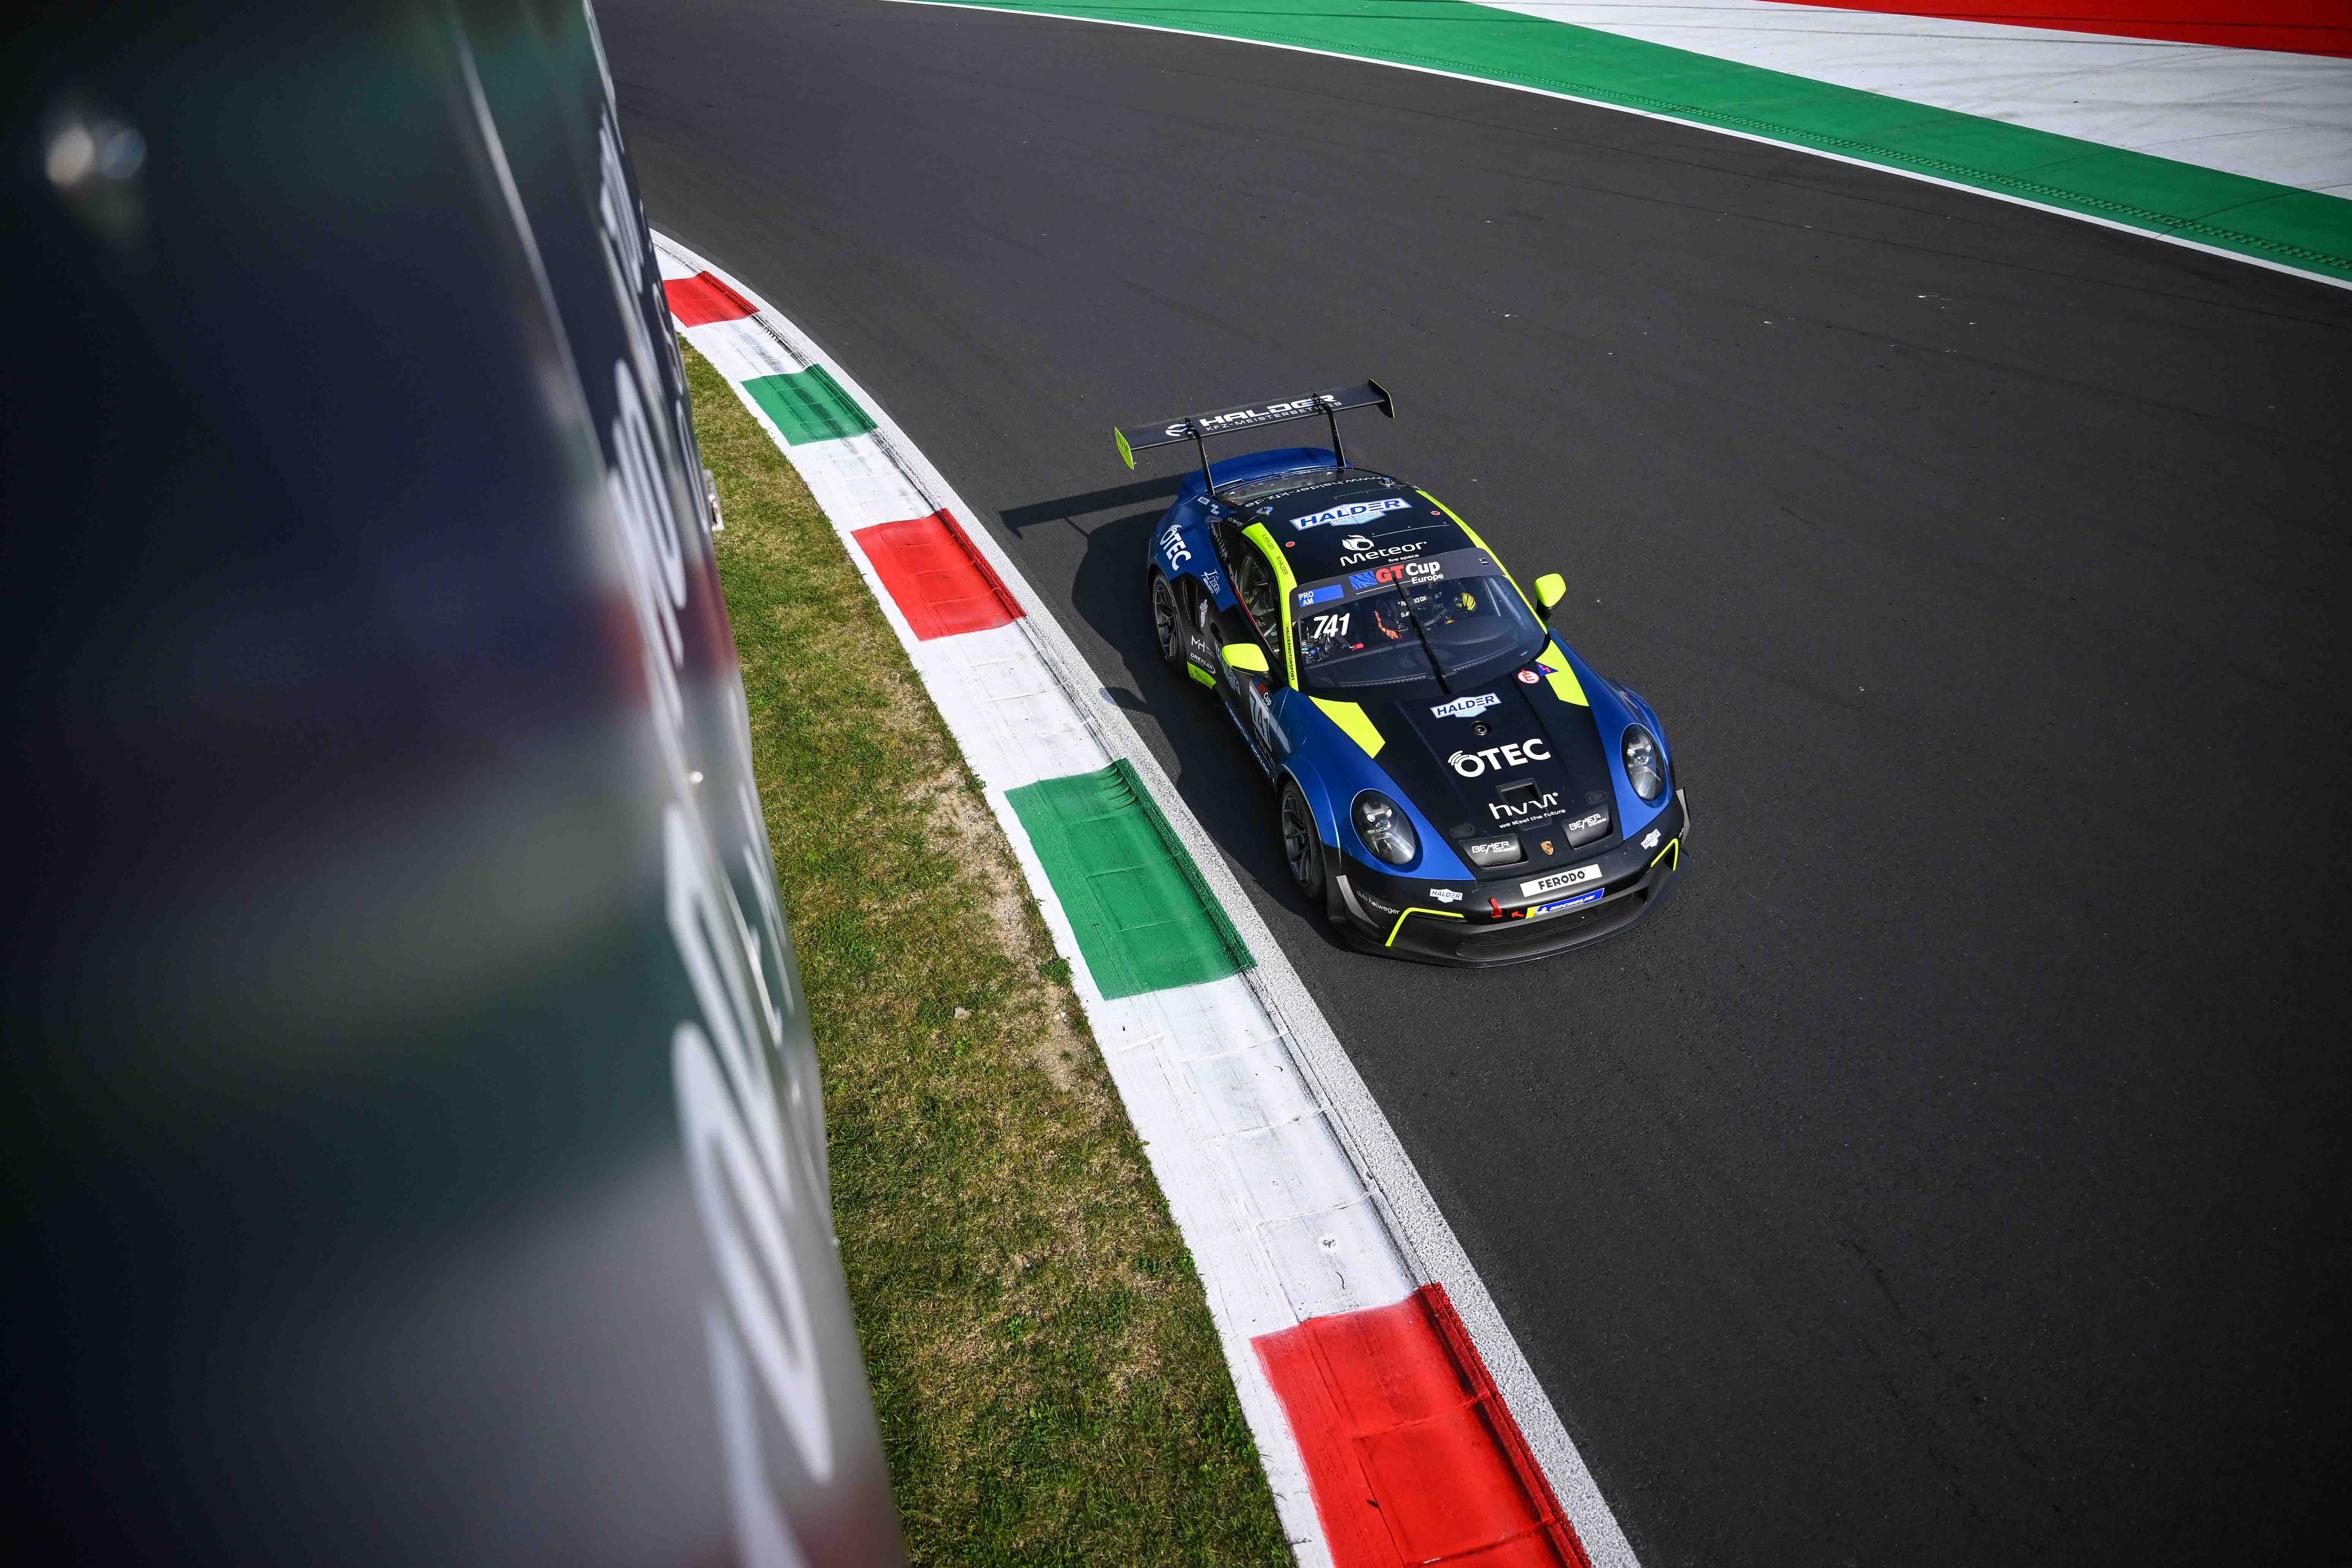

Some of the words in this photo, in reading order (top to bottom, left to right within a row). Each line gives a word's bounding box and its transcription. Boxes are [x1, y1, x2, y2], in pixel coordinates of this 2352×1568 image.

[1300, 500, 1400, 527] HALDER
[1339, 542, 1423, 567] Meteor
[1399, 553, 1420, 562] space
[1375, 564, 1404, 583] GT
[1405, 561, 1440, 576] Cup
[1411, 572, 1444, 584] Europe
[1298, 591, 1314, 600] PRO
[1313, 613, 1350, 639] 741
[1190, 652, 1213, 670] DREXLER
[1285, 626, 1295, 681] HALDERMOTORSPORT
[1437, 695, 1495, 716] HALDER
[1543, 809, 1566, 817] future
[1568, 813, 1601, 831] BEMER
[1472, 841, 1510, 854] BEMER
[1643, 831, 1659, 847] HALDER
[1538, 871, 1585, 890] FERODO
[1369, 897, 1400, 914] holweger
[1549, 895, 1596, 911] MICHELIN
